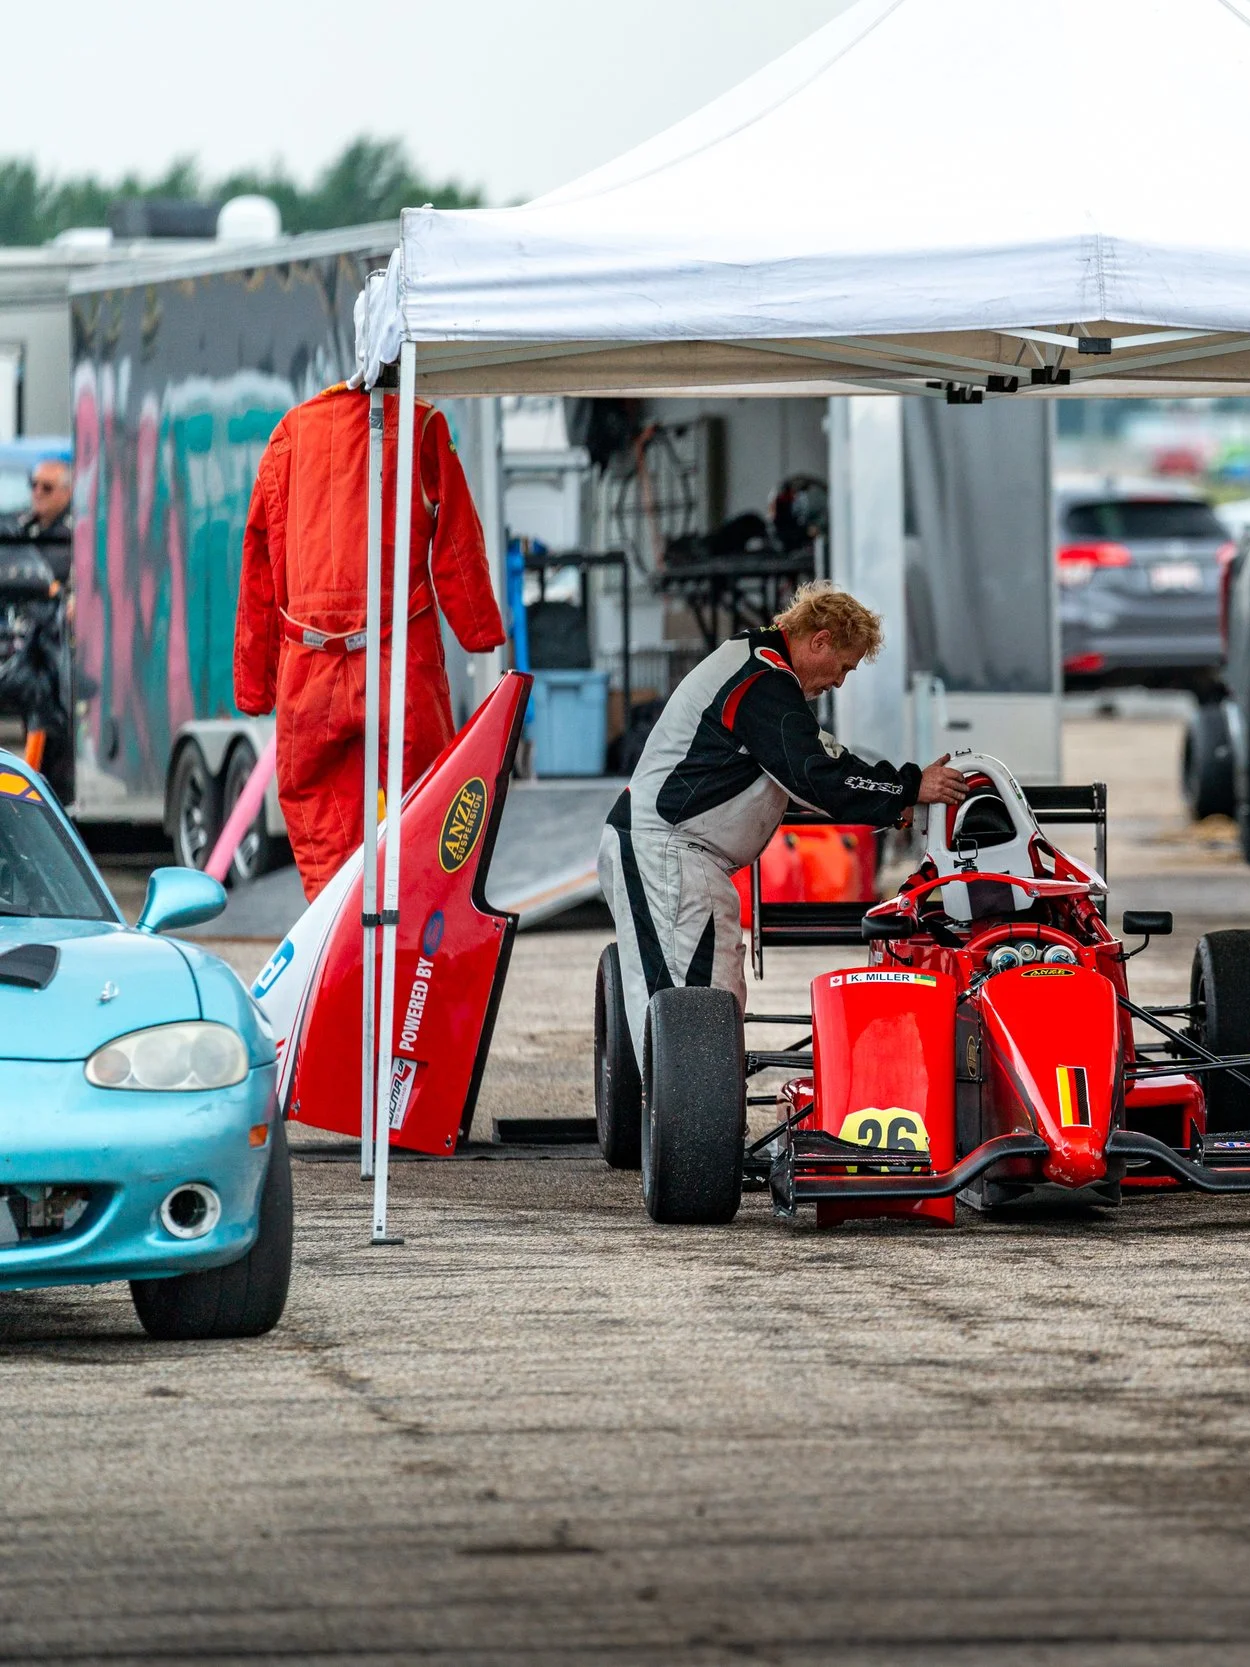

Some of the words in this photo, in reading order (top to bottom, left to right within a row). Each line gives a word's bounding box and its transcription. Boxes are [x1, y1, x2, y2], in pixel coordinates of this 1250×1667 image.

[445, 788, 476, 860] ANZE
[456, 793, 483, 861] SUSPENSION
[399, 980, 429, 1052] POWERED
[415, 957, 434, 979] BY
[850, 974, 862, 982] K.
[866, 973, 910, 981] MILLER
[858, 1117, 917, 1172] 26
